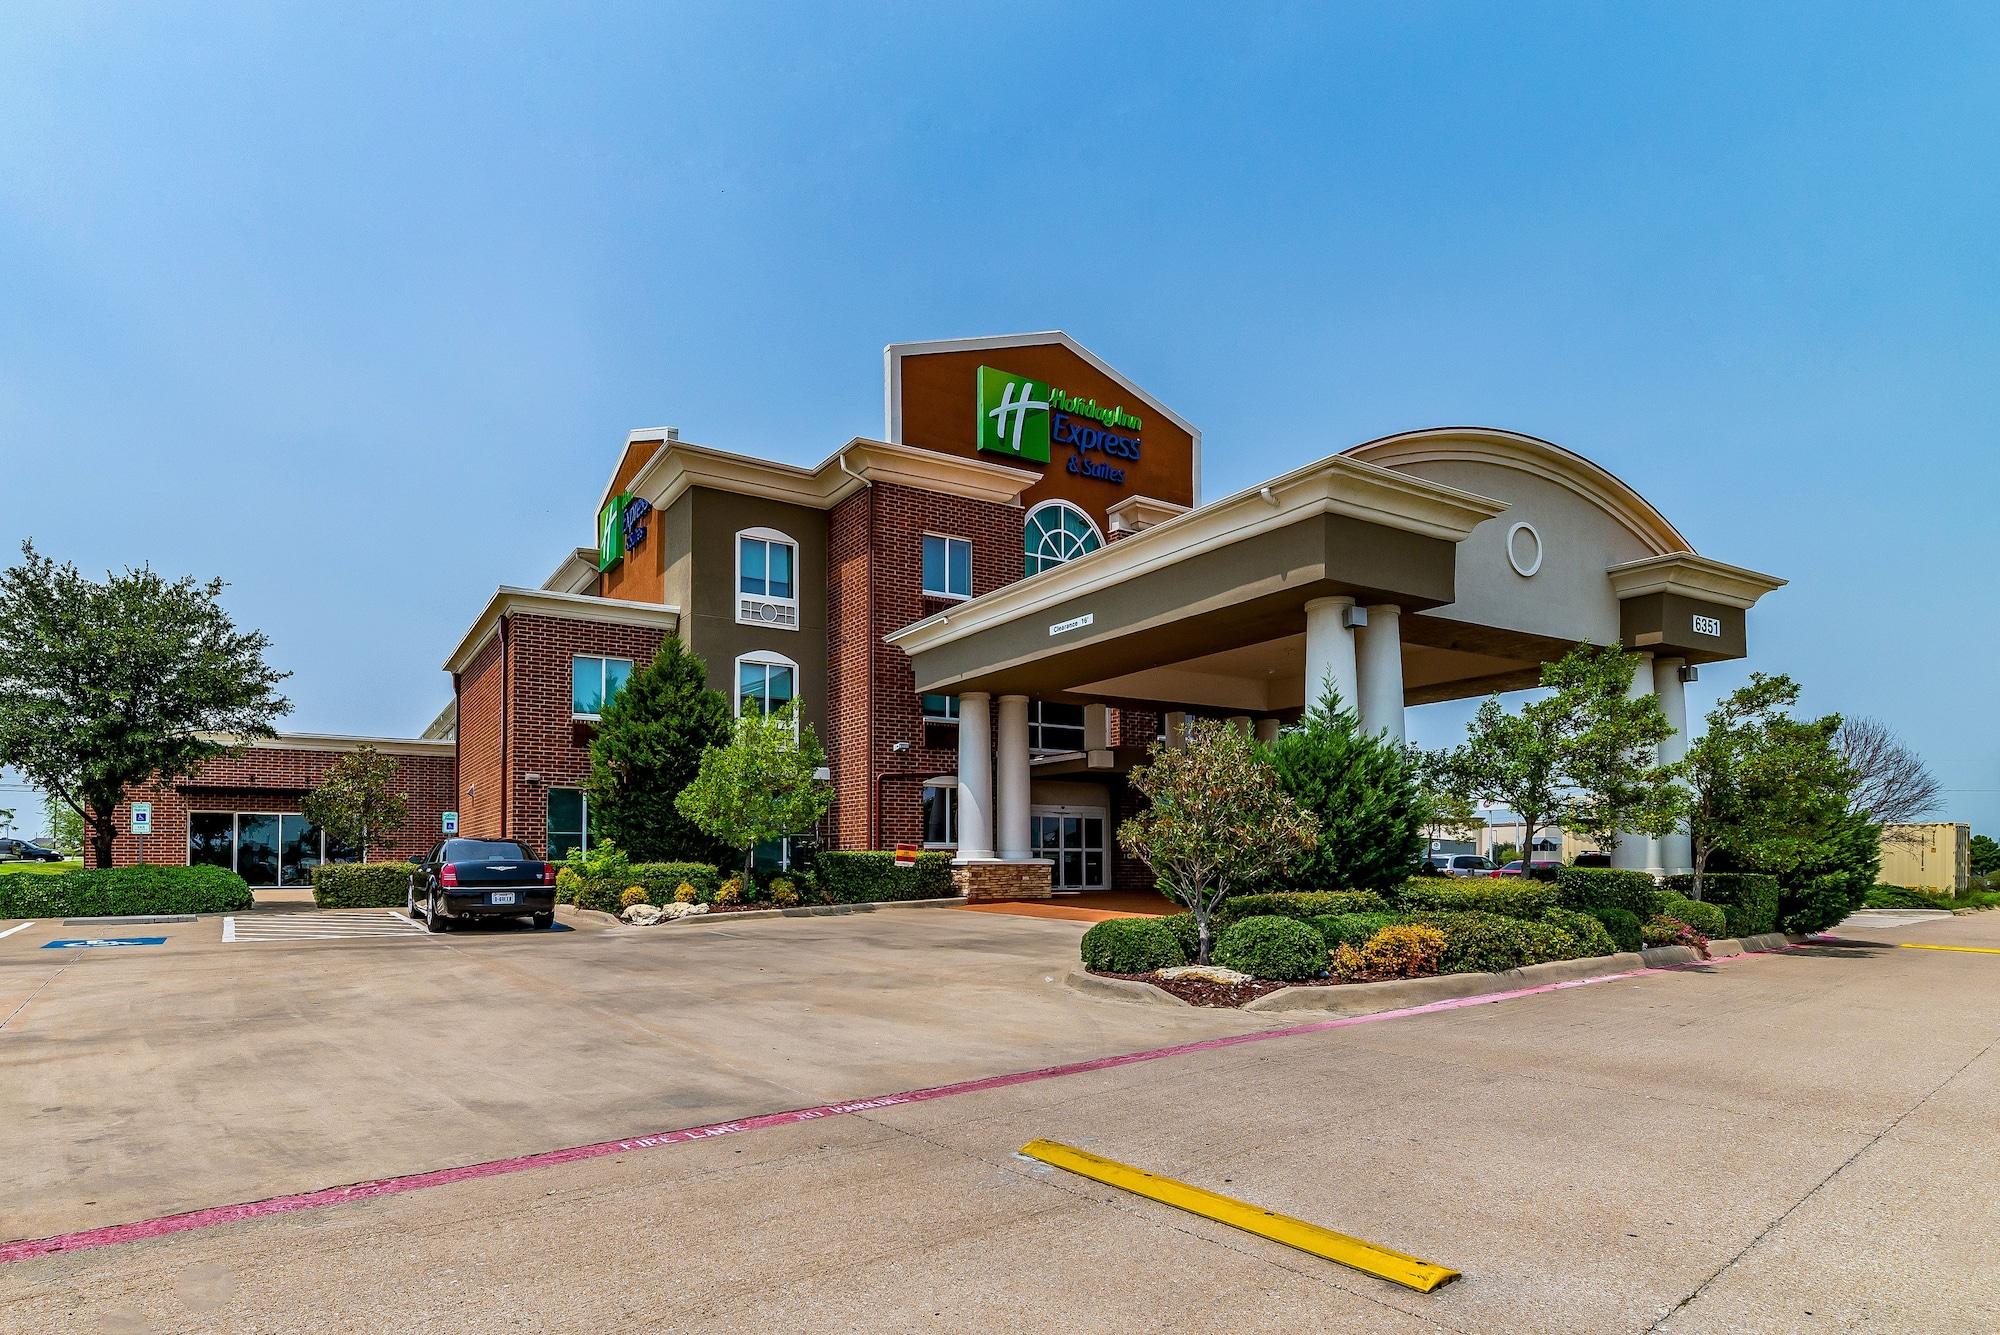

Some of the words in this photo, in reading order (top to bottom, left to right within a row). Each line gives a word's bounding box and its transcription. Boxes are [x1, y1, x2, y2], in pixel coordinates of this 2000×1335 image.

[1048, 387, 1114, 428] Holiday
[1114, 405, 1143, 431] Inn
[1052, 413, 1142, 461] Express
[1067, 455, 1080, 474] &
[1082, 459, 1125, 483] Suites
[1054, 622, 1078, 632] Clearance
[1696, 617, 1717, 635] 6351
[619, 1135, 679, 1151] FIRE
[684, 1123, 749, 1139] LANE
